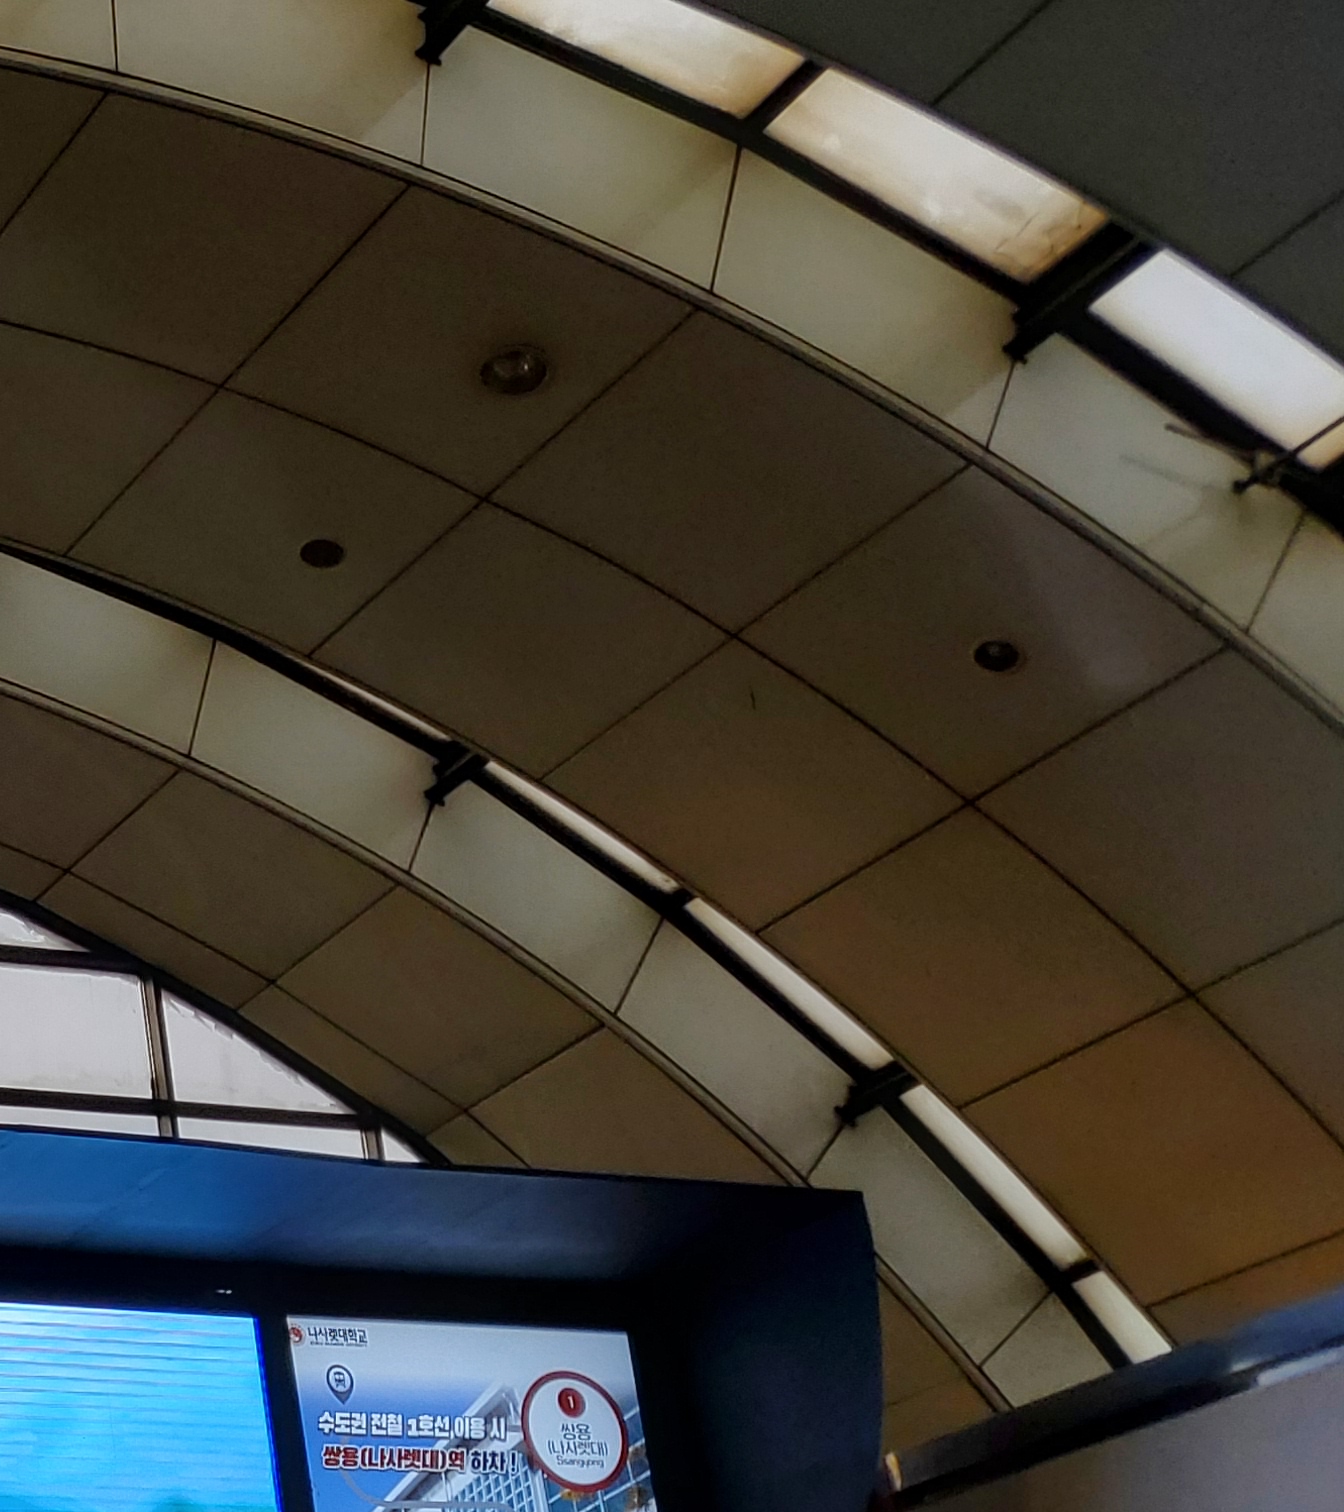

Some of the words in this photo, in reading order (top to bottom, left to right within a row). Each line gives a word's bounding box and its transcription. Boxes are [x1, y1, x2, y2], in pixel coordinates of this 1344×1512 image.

[307, 1326, 368, 1345] 나사렛대학교
[318, 1411, 367, 1436] 수도권
[370, 1413, 403, 1437] 전철
[490, 1417, 507, 1441] 시
[561, 1424, 592, 1440] 쌍용
[548, 1441, 608, 1457] (나사렛대)
[322, 1446, 465, 1472] 쌍용(나사렛대)역
[470, 1450, 506, 1473] 하차
